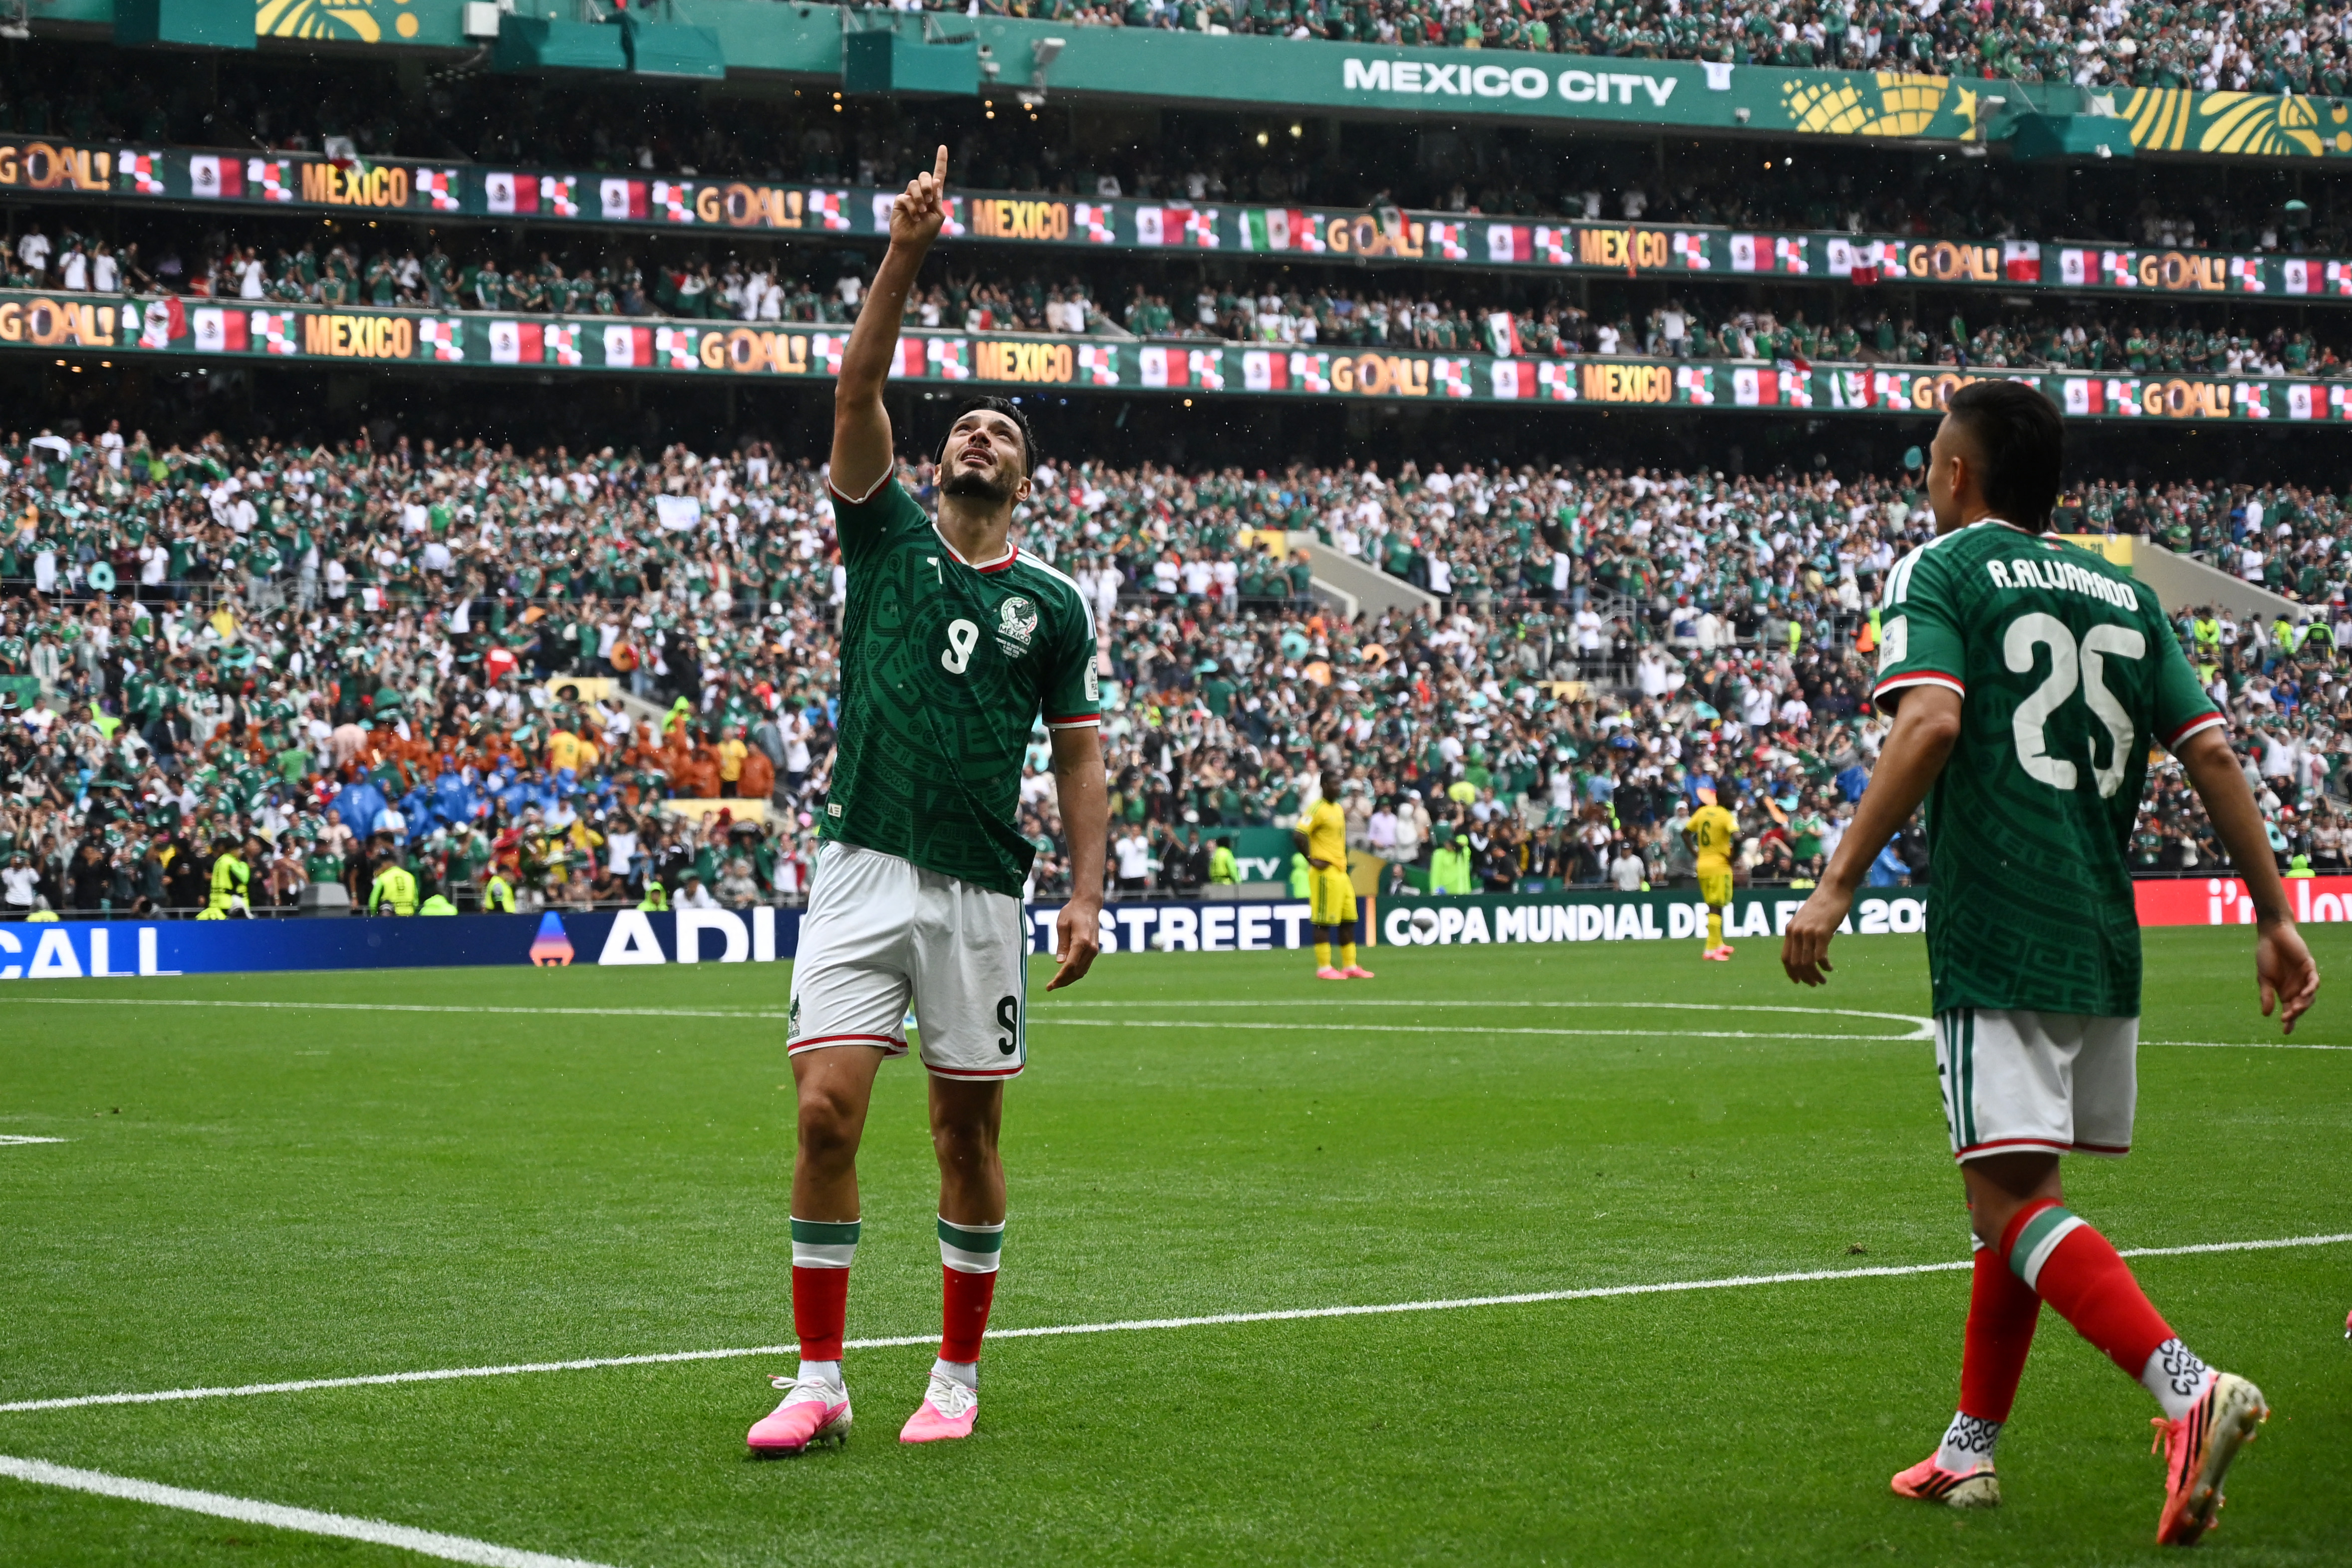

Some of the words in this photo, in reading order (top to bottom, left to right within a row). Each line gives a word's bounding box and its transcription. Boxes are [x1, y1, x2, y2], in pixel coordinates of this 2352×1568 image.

[1343, 58, 1549, 99] MEXICO
[1558, 70, 1678, 106] CITY
[302, 163, 408, 207] MEXICO
[697, 183, 802, 227] GOAL!
[973, 199, 1068, 240] MEXICO
[1580, 228, 1668, 267] MEXCO
[1909, 240, 1998, 281] GOAL!
[2139, 251, 2226, 290] GOAL!
[0, 298, 115, 347] GOAL!
[304, 314, 413, 359] MEXICO
[700, 328, 807, 373] GOAL!
[976, 341, 1073, 383] MEXICO
[1331, 353, 1429, 396] GOAL!
[1583, 364, 1672, 403] MEXICO
[2143, 378, 2231, 418] GOAL!
[941, 619, 979, 674] 9
[2003, 612, 2145, 798] 25
[1701, 821, 1710, 846] 6
[598, 905, 776, 965] ADI
[1385, 907, 1491, 946] COPA
[1496, 903, 1663, 943] MUNDIAL
[1668, 903, 1709, 939] DE
[1723, 901, 1771, 937] LA
[997, 995, 1018, 1055] 9
